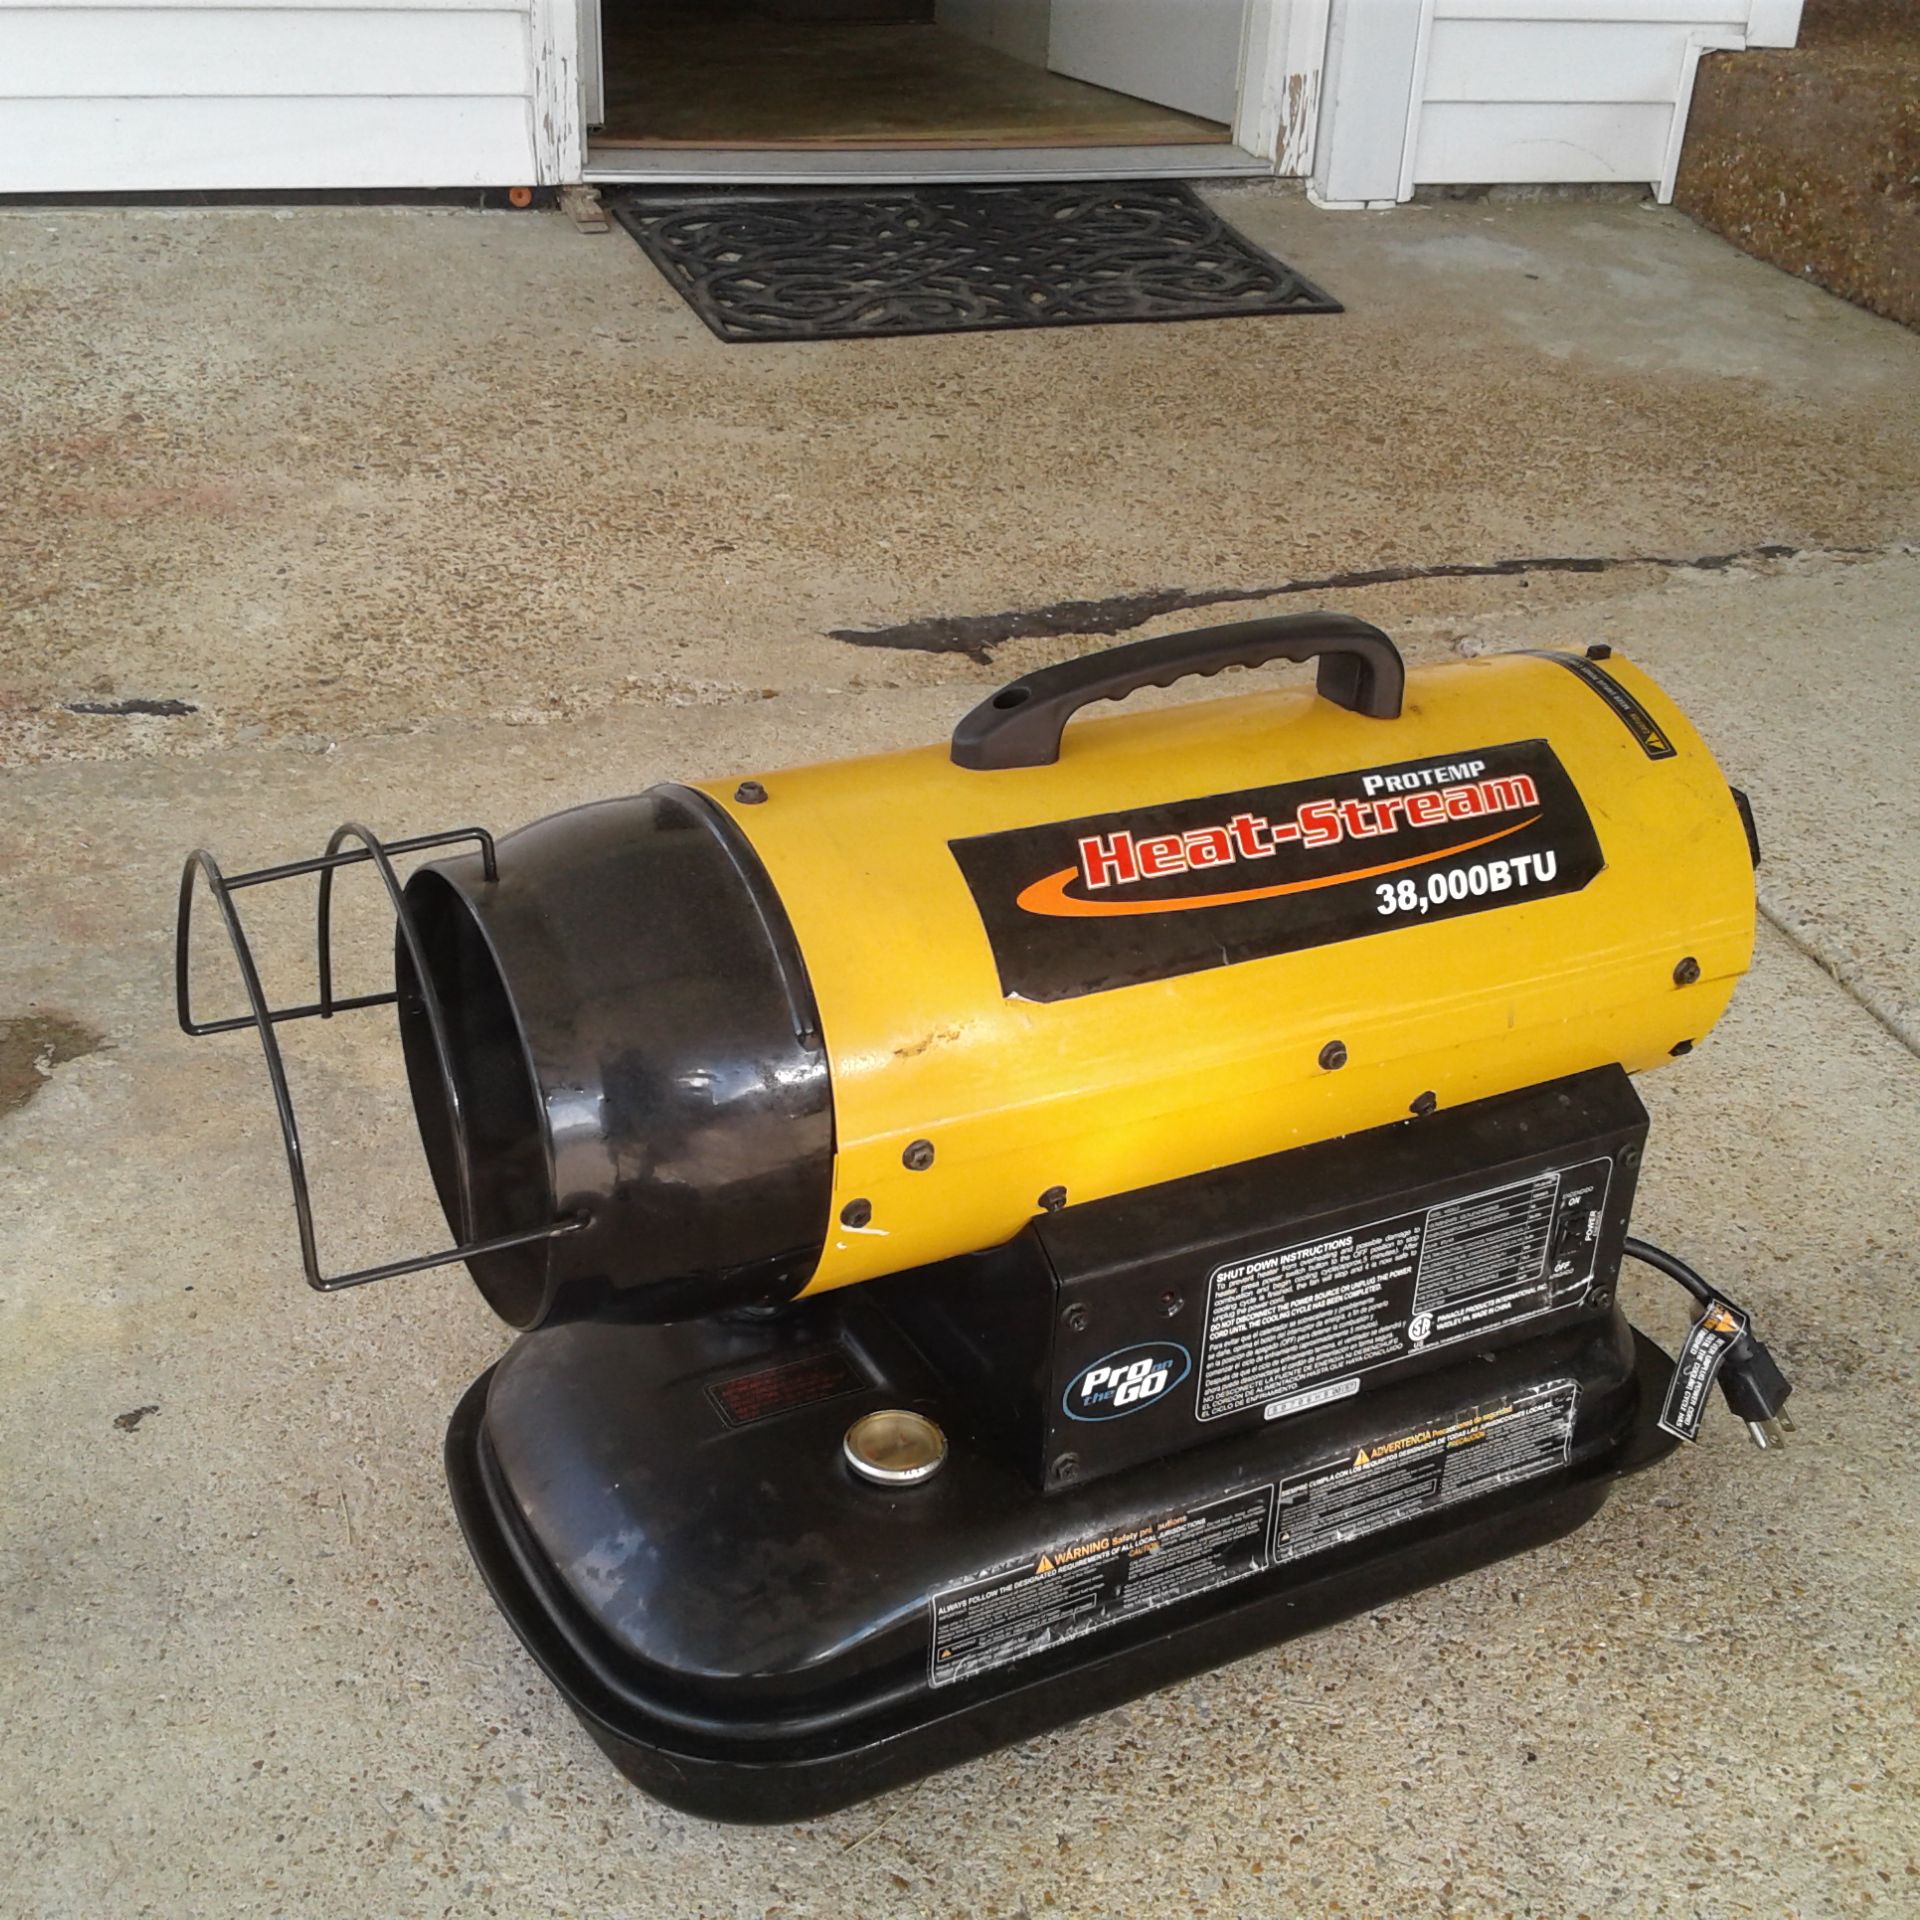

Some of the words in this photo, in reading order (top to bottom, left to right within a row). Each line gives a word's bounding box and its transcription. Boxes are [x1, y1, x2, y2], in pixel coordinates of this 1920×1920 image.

[1362, 760, 1486, 797] PROTEMP
[1078, 774, 1540, 890] Heat-Stream
[1376, 850, 1558, 915] 38,000BTU
[1585, 1210, 1597, 1241] POWER
[1216, 1266, 1245, 1283] SHUT
[1246, 1257, 1278, 1274] DOWN
[1280, 1235, 1353, 1264] INSTRUCTIONS
[1081, 1358, 1153, 1397] Pro
[1083, 1389, 1115, 1407] the
[1371, 1431, 1431, 1458] ADVERTENCIA
[1054, 1538, 1110, 1566] WARNING
[1111, 1531, 1138, 1546] Safety
[938, 1600, 967, 1615] ALWAYS
[968, 1589, 999, 1605] FOLLOW
[999, 1583, 1013, 1594] THE
[1121, 1542, 1134, 1552] ALL
